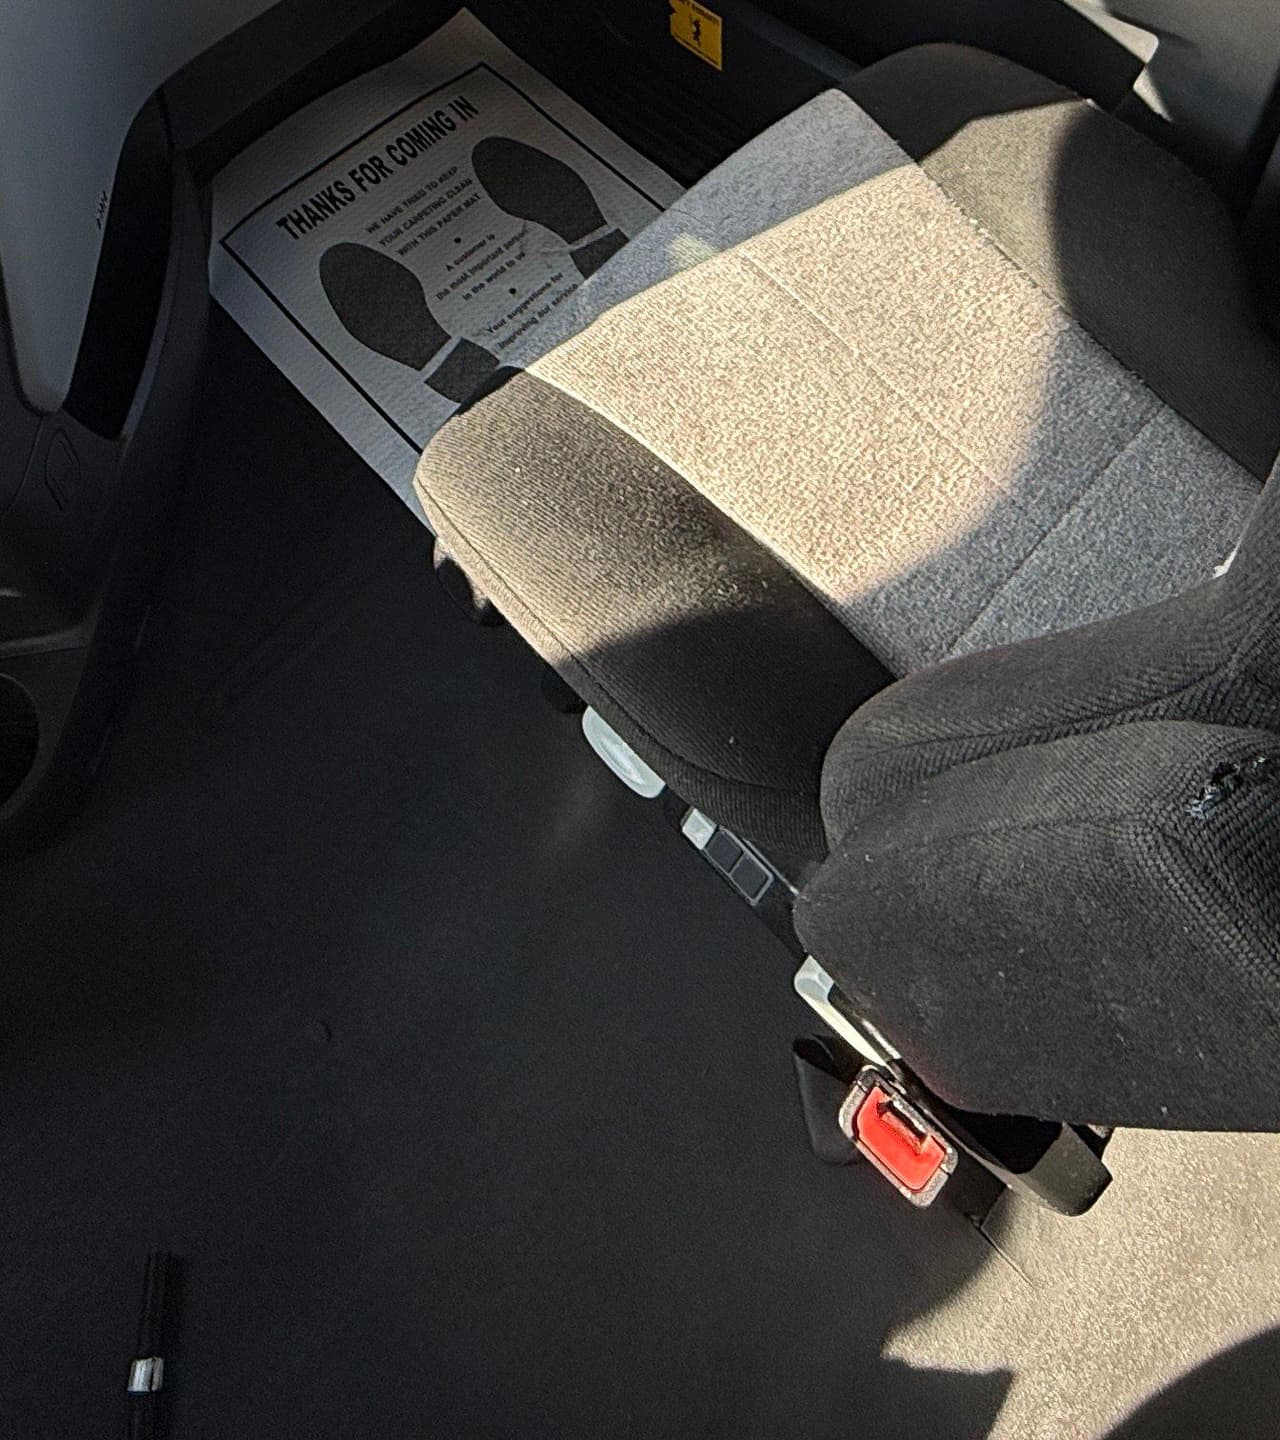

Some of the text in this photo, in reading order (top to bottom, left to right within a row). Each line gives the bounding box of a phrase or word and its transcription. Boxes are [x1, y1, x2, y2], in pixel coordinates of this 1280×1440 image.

[275, 95, 479, 240] THANKS FOR COMING IN
[366, 166, 458, 234] WE HAVE TRIED TO KEEP
[378, 178, 473, 247] YOUR CARPETING CLEAN
[396, 192, 482, 256] WITH THIS PAPER MAT
[435, 229, 530, 302] the most important person
[445, 233, 496, 272] A customer is
[471, 282, 486, 294] the
[486, 265, 507, 283] world
[505, 259, 516, 268] to
[486, 271, 564, 334] Your suggestions for
[537, 305, 552, 319] our
[551, 283, 579, 307] service
